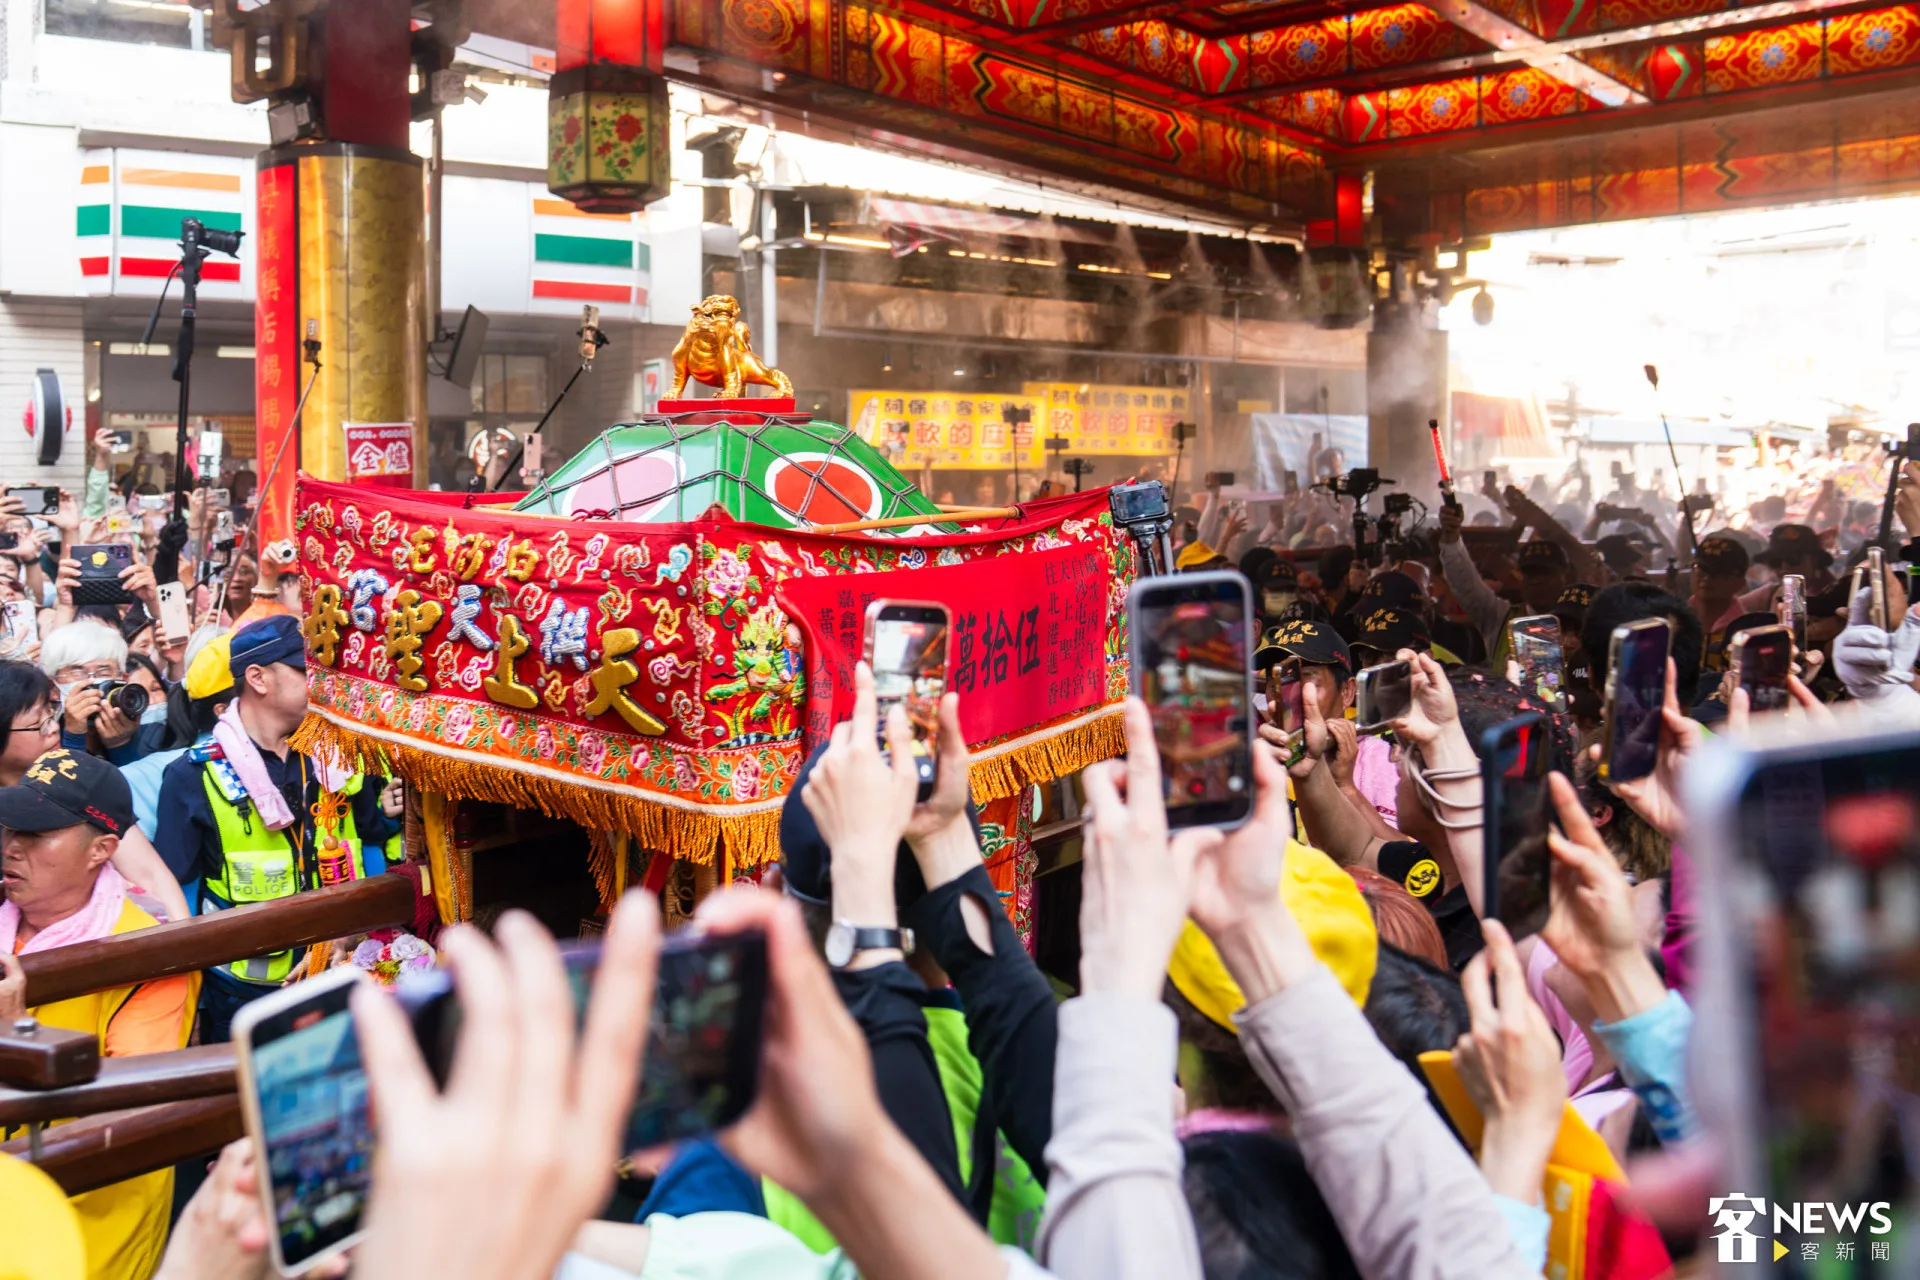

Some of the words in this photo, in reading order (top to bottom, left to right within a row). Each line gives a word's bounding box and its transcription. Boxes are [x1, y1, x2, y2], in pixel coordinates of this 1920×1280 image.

[352, 442, 410, 474] 金爐
[304, 584, 669, 737] 天上聖母
[233, 882, 290, 896] POLICE
